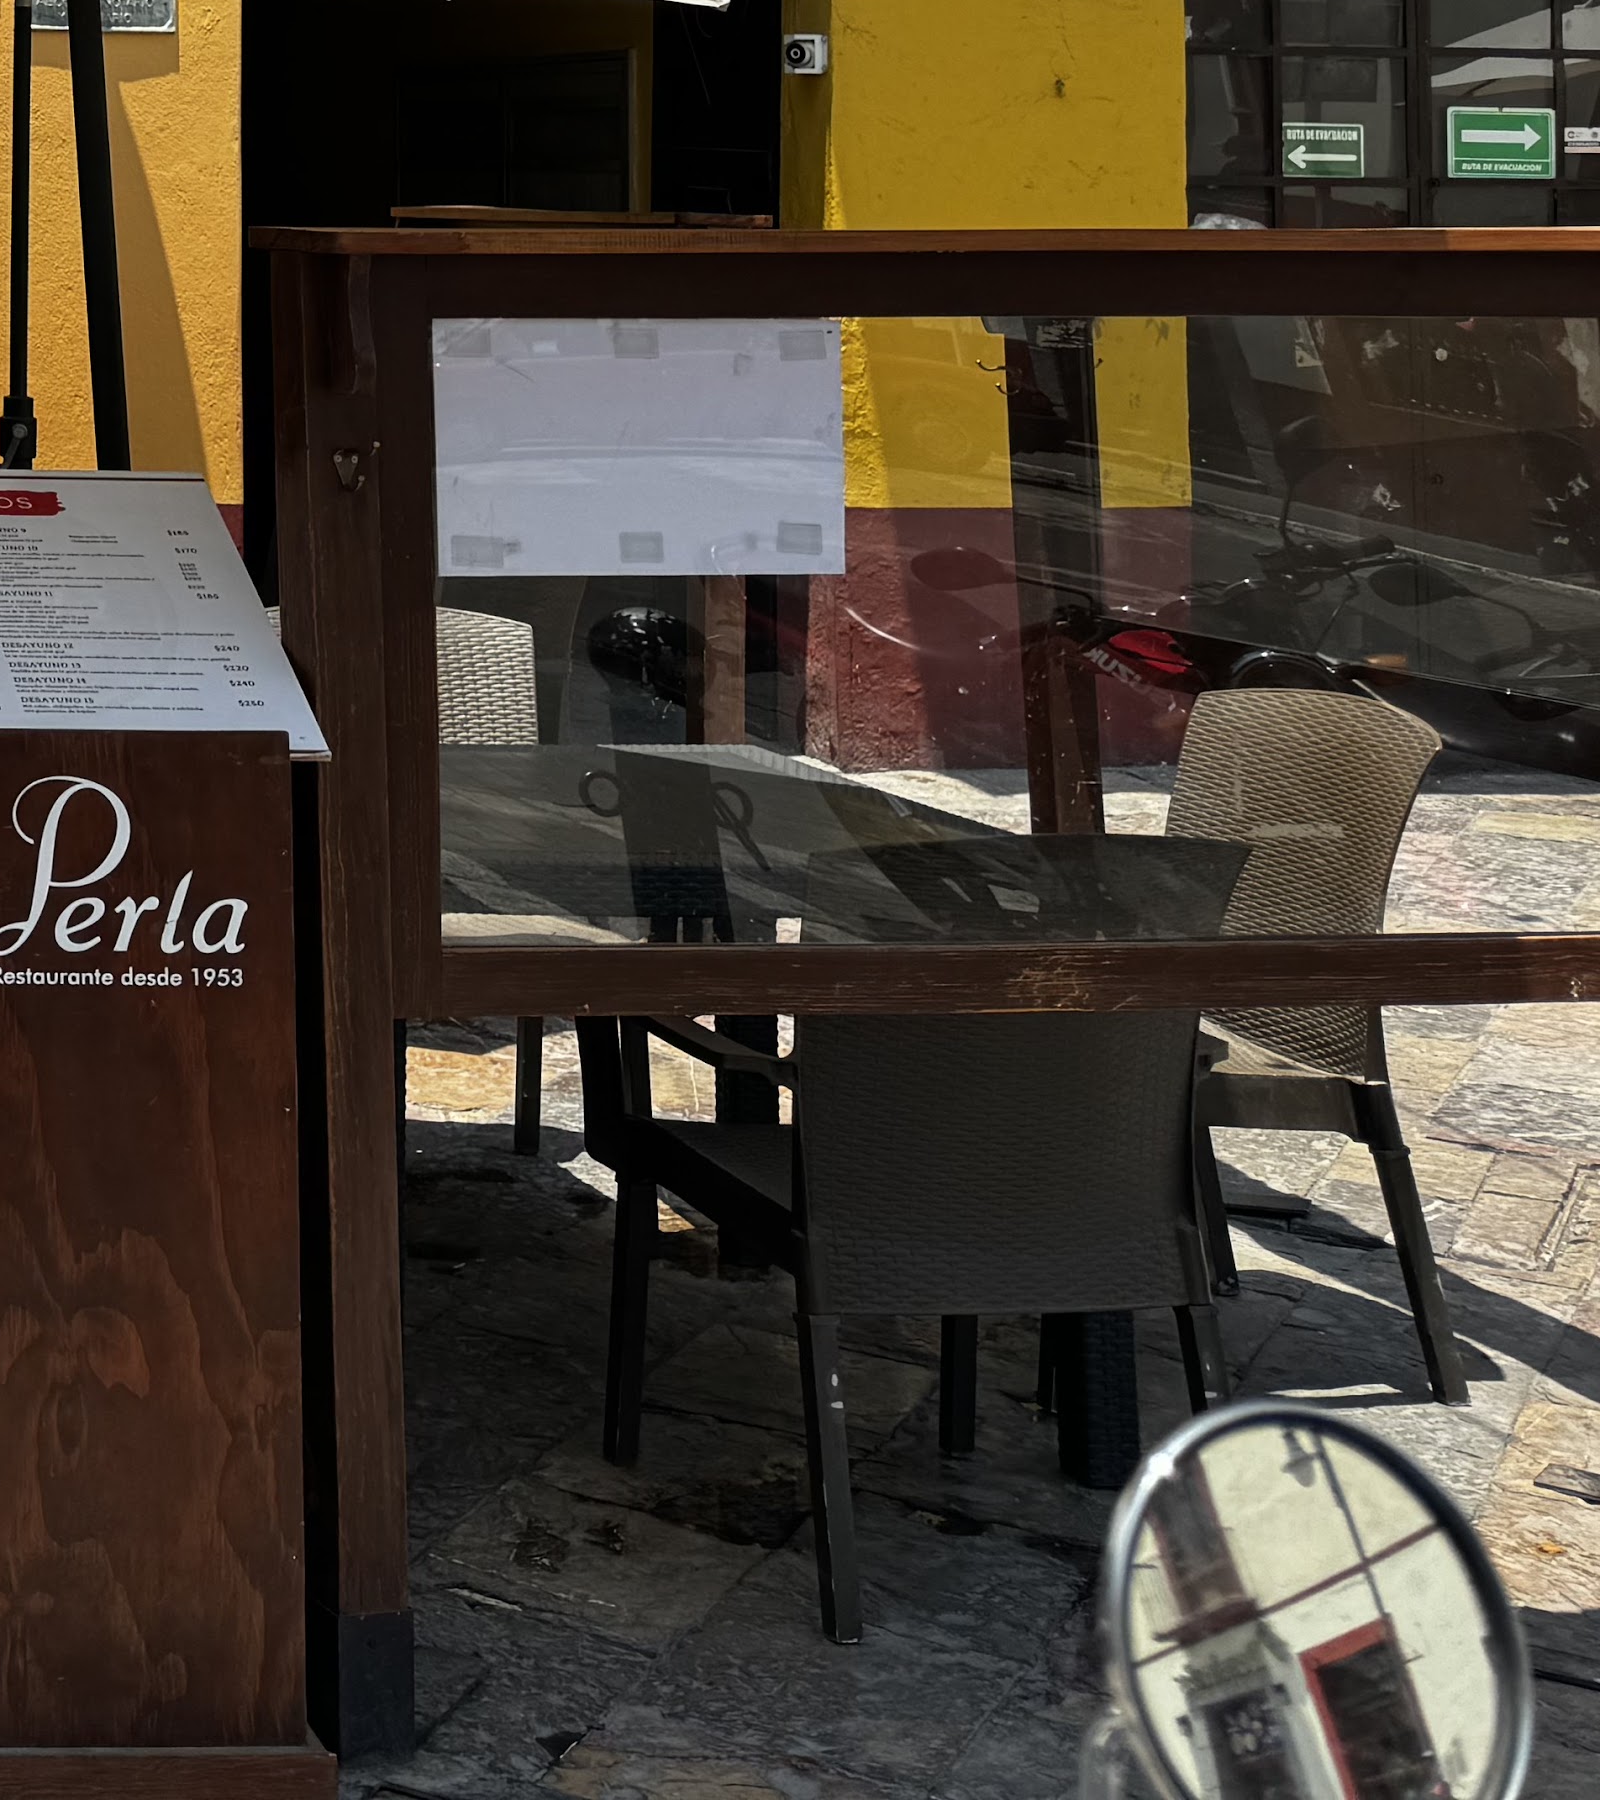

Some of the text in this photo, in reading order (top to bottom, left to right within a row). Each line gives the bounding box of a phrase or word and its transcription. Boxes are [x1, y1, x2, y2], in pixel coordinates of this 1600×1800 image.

[1286, 128, 1305, 142] RUTA
[1306, 128, 1315, 142] DE
[1461, 162, 1481, 171] RUTA
[1482, 163, 1492, 171] DE
[1, 641, 61, 649] DESAYUNO
[8, 661, 68, 669] DESAYUNO
[13, 676, 74, 684] DESAYUNO
[20, 696, 82, 704] DESAYUNO
[120, 966, 183, 988] desde
[190, 967, 244, 988] 1953
